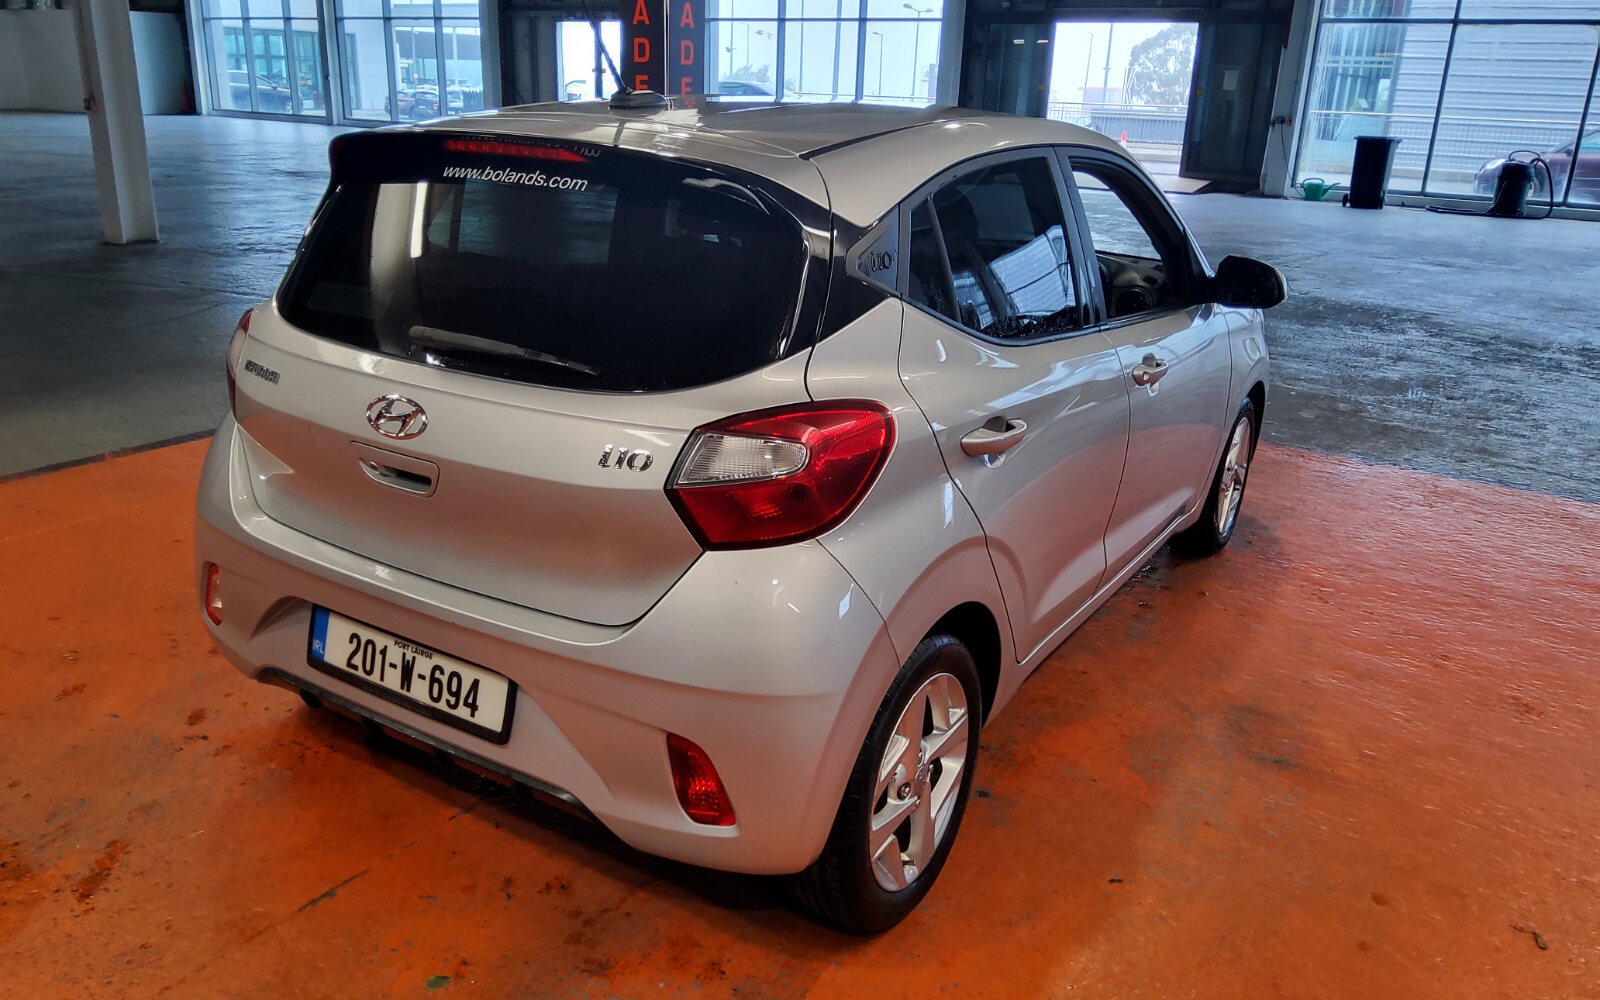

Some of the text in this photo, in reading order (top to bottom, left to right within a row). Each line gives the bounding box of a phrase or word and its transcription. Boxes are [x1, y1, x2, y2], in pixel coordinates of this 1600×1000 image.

[443, 166, 588, 191] www.bolands.com
[598, 443, 654, 472] i10
[312, 639, 324, 655] IRL
[394, 640, 410, 651] PORT
[346, 633, 480, 718] 201-W-694
